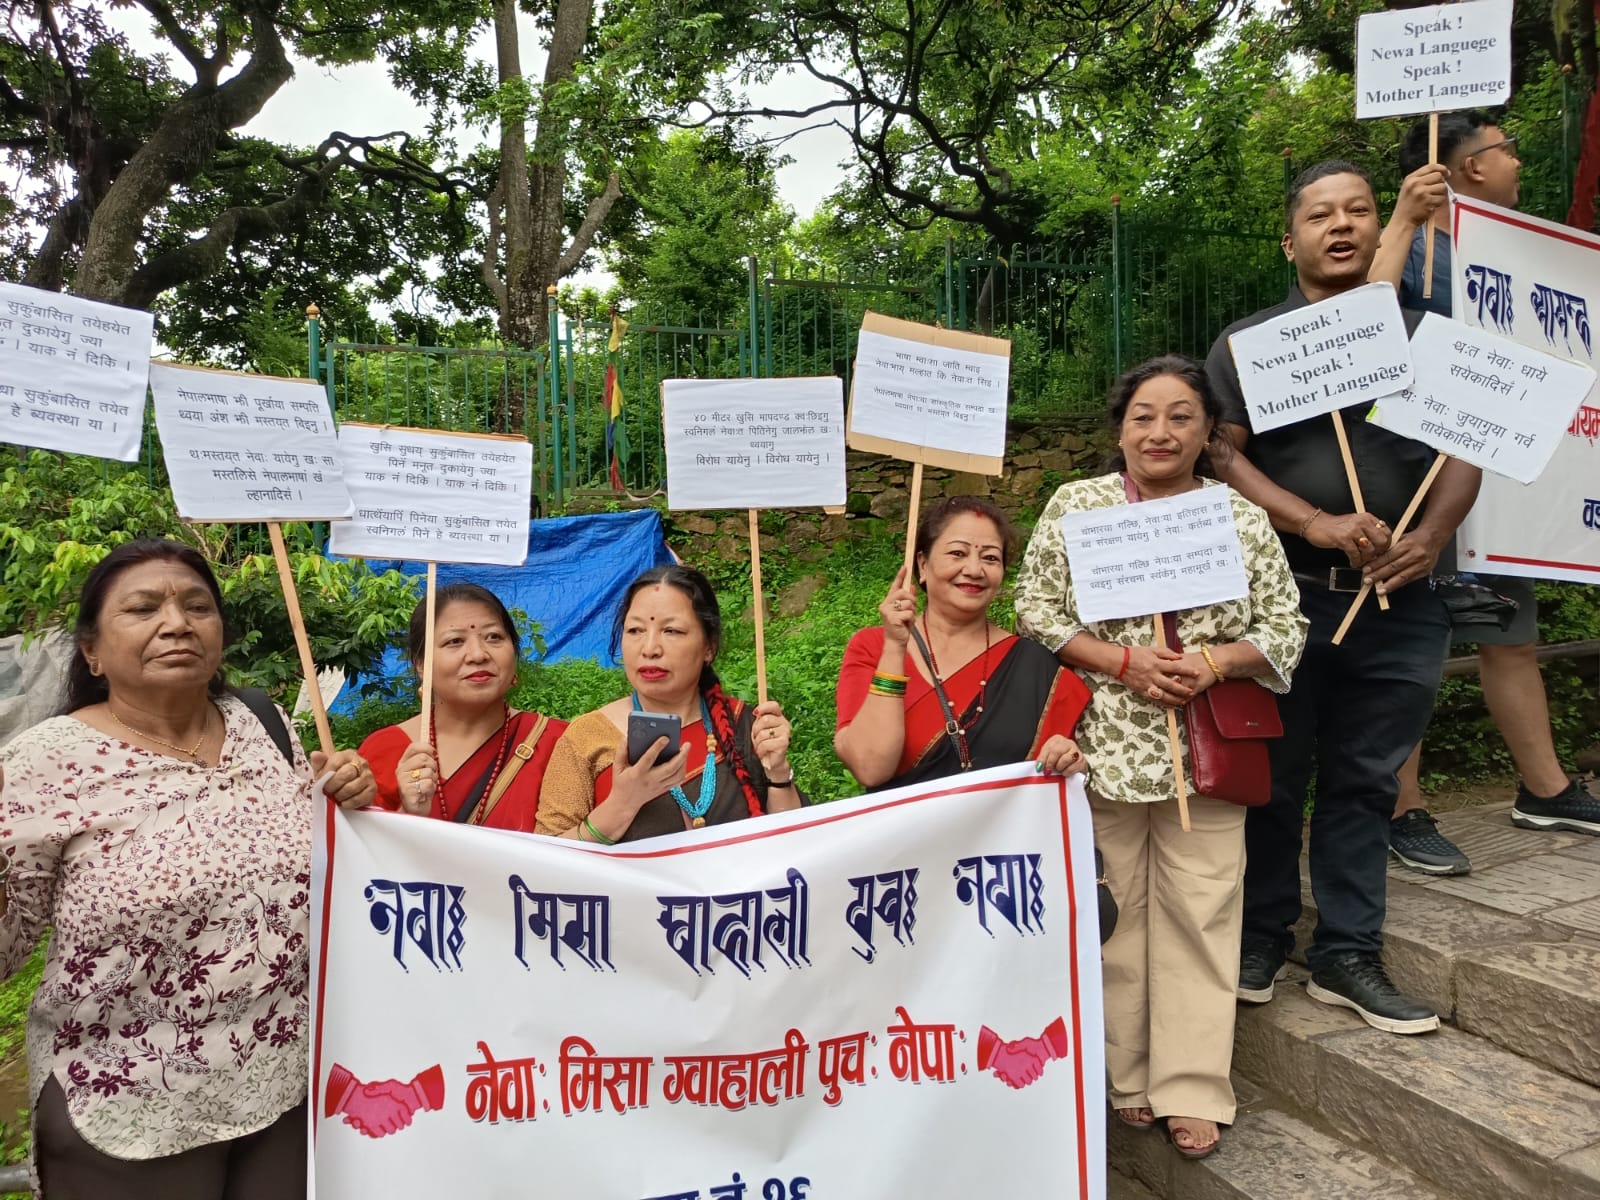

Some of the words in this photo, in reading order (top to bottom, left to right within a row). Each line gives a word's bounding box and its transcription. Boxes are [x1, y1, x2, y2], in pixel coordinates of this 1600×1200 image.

[1404, 18, 1452, 38] Speak
[1371, 48, 1414, 61] Newa
[1403, 61, 1451, 81] Speak
[1365, 88, 1423, 104] Mother
[22, 322, 71, 344] दुकायेगु
[80, 334, 102, 347] ज्या
[1280, 314, 1332, 342] Speak
[29, 342, 56, 356] याक
[66, 345, 77, 360] नं
[86, 353, 117, 368] दिकि
[1251, 351, 1298, 374] Newa
[1487, 350, 1515, 370] नेवाः
[1521, 365, 1548, 383] धाये
[1290, 358, 1343, 385] Speak
[10, 403, 22, 417] हे
[88, 419, 102, 430] या
[100, 401, 129, 416] तयेत
[1257, 390, 1319, 418] Mother
[1424, 395, 1450, 415] नेवाः
[1514, 430, 1537, 449] गर्व
[696, 454, 720, 465] विरोध
[766, 453, 789, 464] विरोध
[365, 472, 384, 481] याक
[445, 479, 465, 488] याक
[464, 1041, 551, 1124] नेवाः
[558, 1035, 655, 1117] मिसा
[662, 1028, 810, 1111] ग्वाहाली
[818, 1031, 878, 1107] पुचः
[886, 1006, 968, 1084] नेपाः
